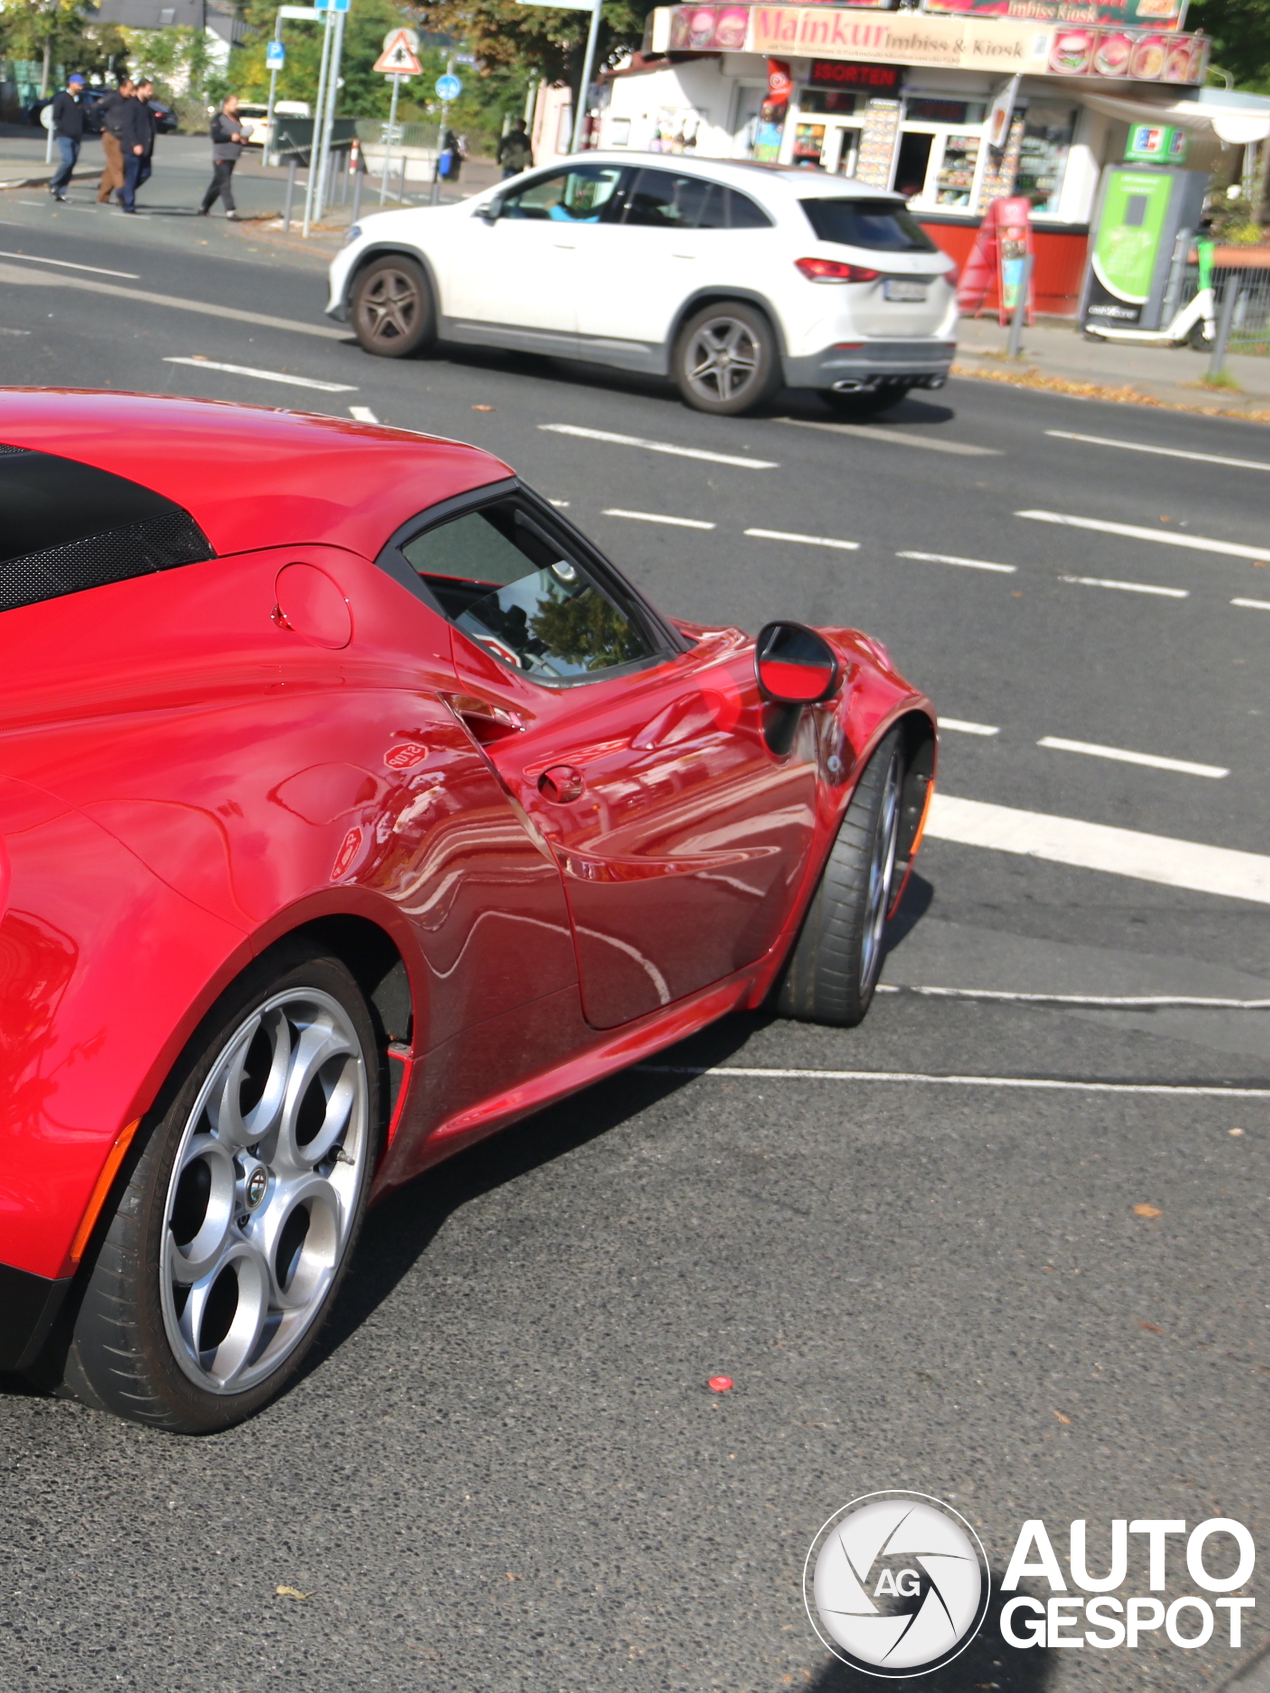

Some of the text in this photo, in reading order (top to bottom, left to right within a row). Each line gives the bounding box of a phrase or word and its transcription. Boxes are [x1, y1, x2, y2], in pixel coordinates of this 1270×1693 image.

[1007, 1, 1056, 19] Imbiss
[1057, 4, 1097, 23] Kiosk
[757, 9, 888, 48] Mainkur
[270, 45, 280, 57] P
[884, 33, 1024, 58] Imbiss & Kiosk
